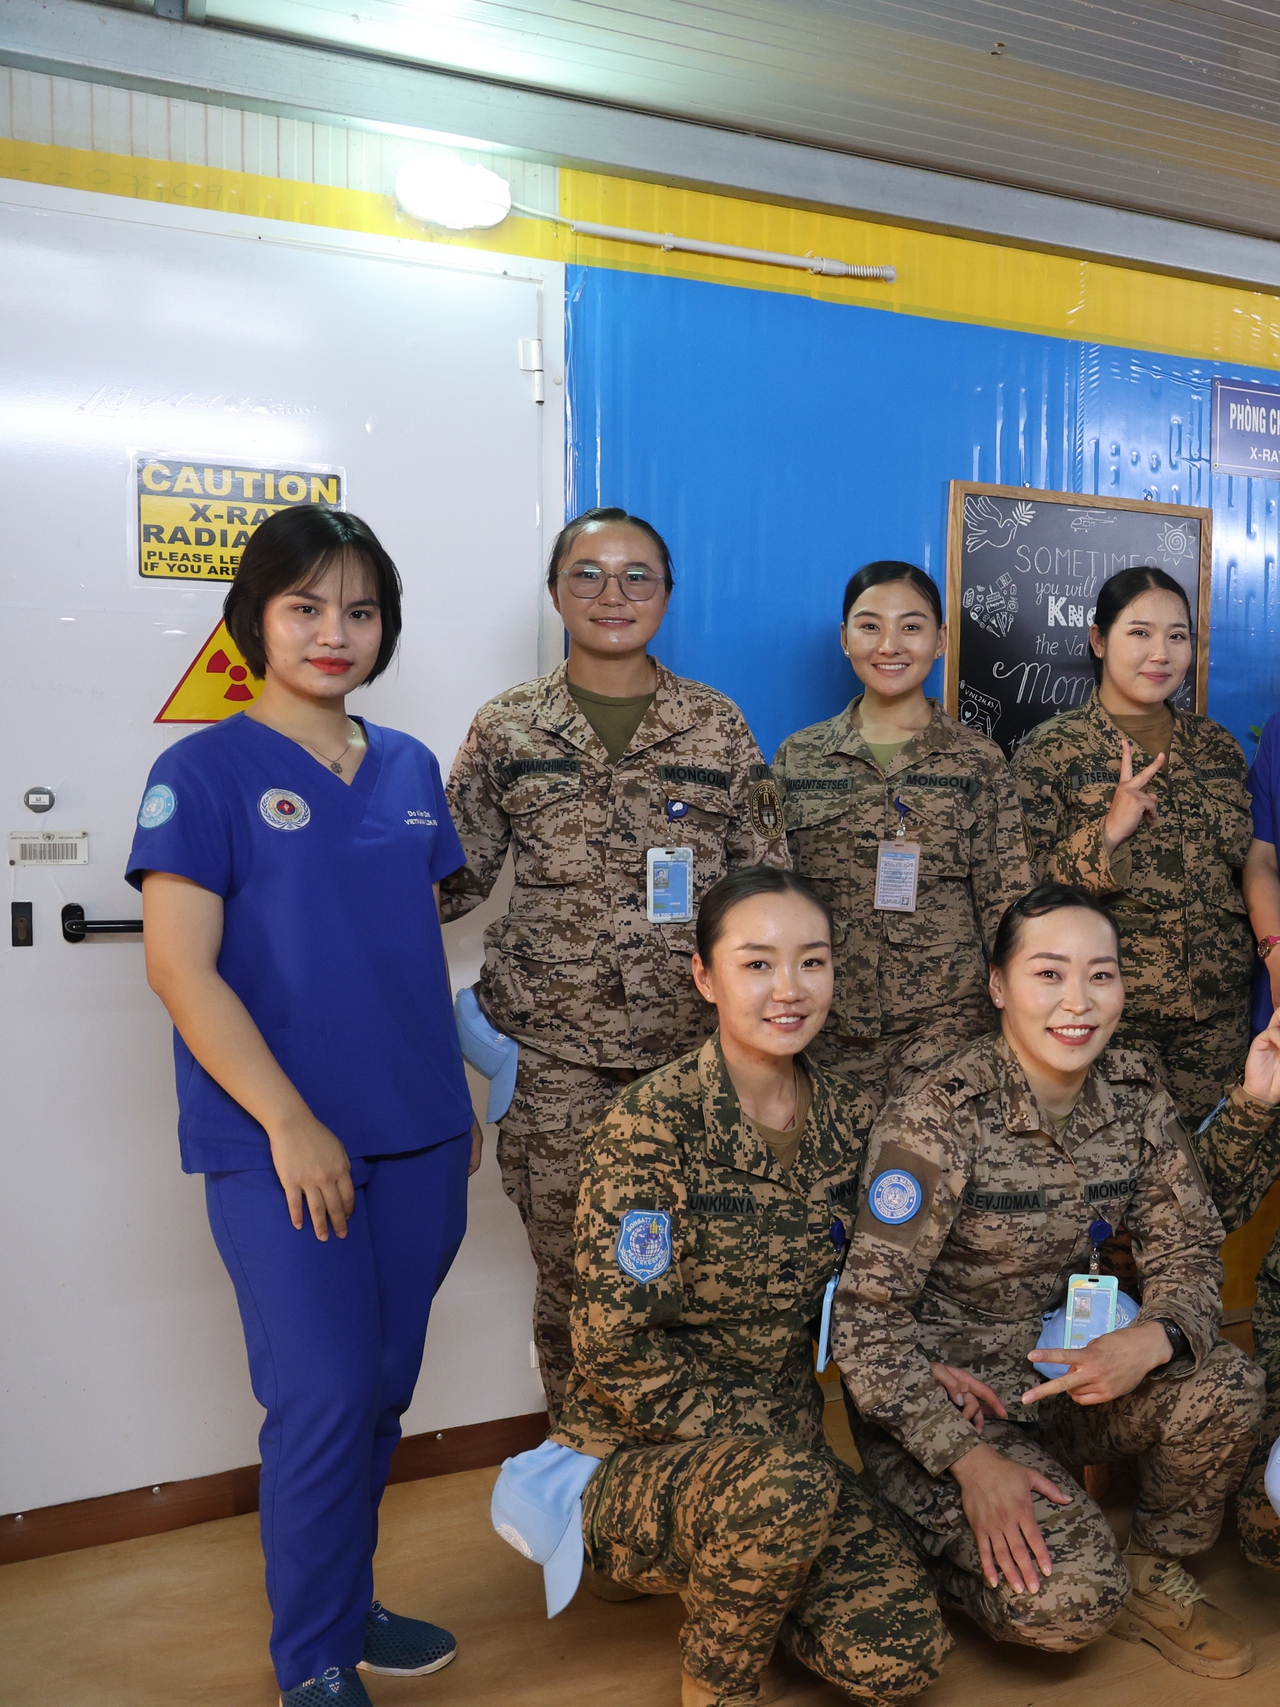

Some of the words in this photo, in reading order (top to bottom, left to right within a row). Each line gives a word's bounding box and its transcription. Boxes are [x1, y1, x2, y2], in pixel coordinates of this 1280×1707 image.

[1229, 398, 1267, 434] PHÒNG
[141, 463, 338, 505] CAUTION
[188, 503, 281, 526] X-RA
[142, 523, 252, 549] RADIA
[143, 561, 159, 572] IF
[166, 562, 202, 574] YOU
[207, 566, 240, 576] ARE
[146, 550, 213, 564] PLEASE
[219, 555, 242, 565] LE
[1034, 581, 1060, 605] you
[1064, 576, 1098, 598] will
[1035, 633, 1059, 656] the
[1064, 634, 1089, 656] Val
[788, 779, 849, 791] UGANTSETSEG
[1200, 768, 1239, 779] MONGOL
[1088, 1178, 1138, 1201] MONGO
[688, 1195, 755, 1214] UNKHZAYA
